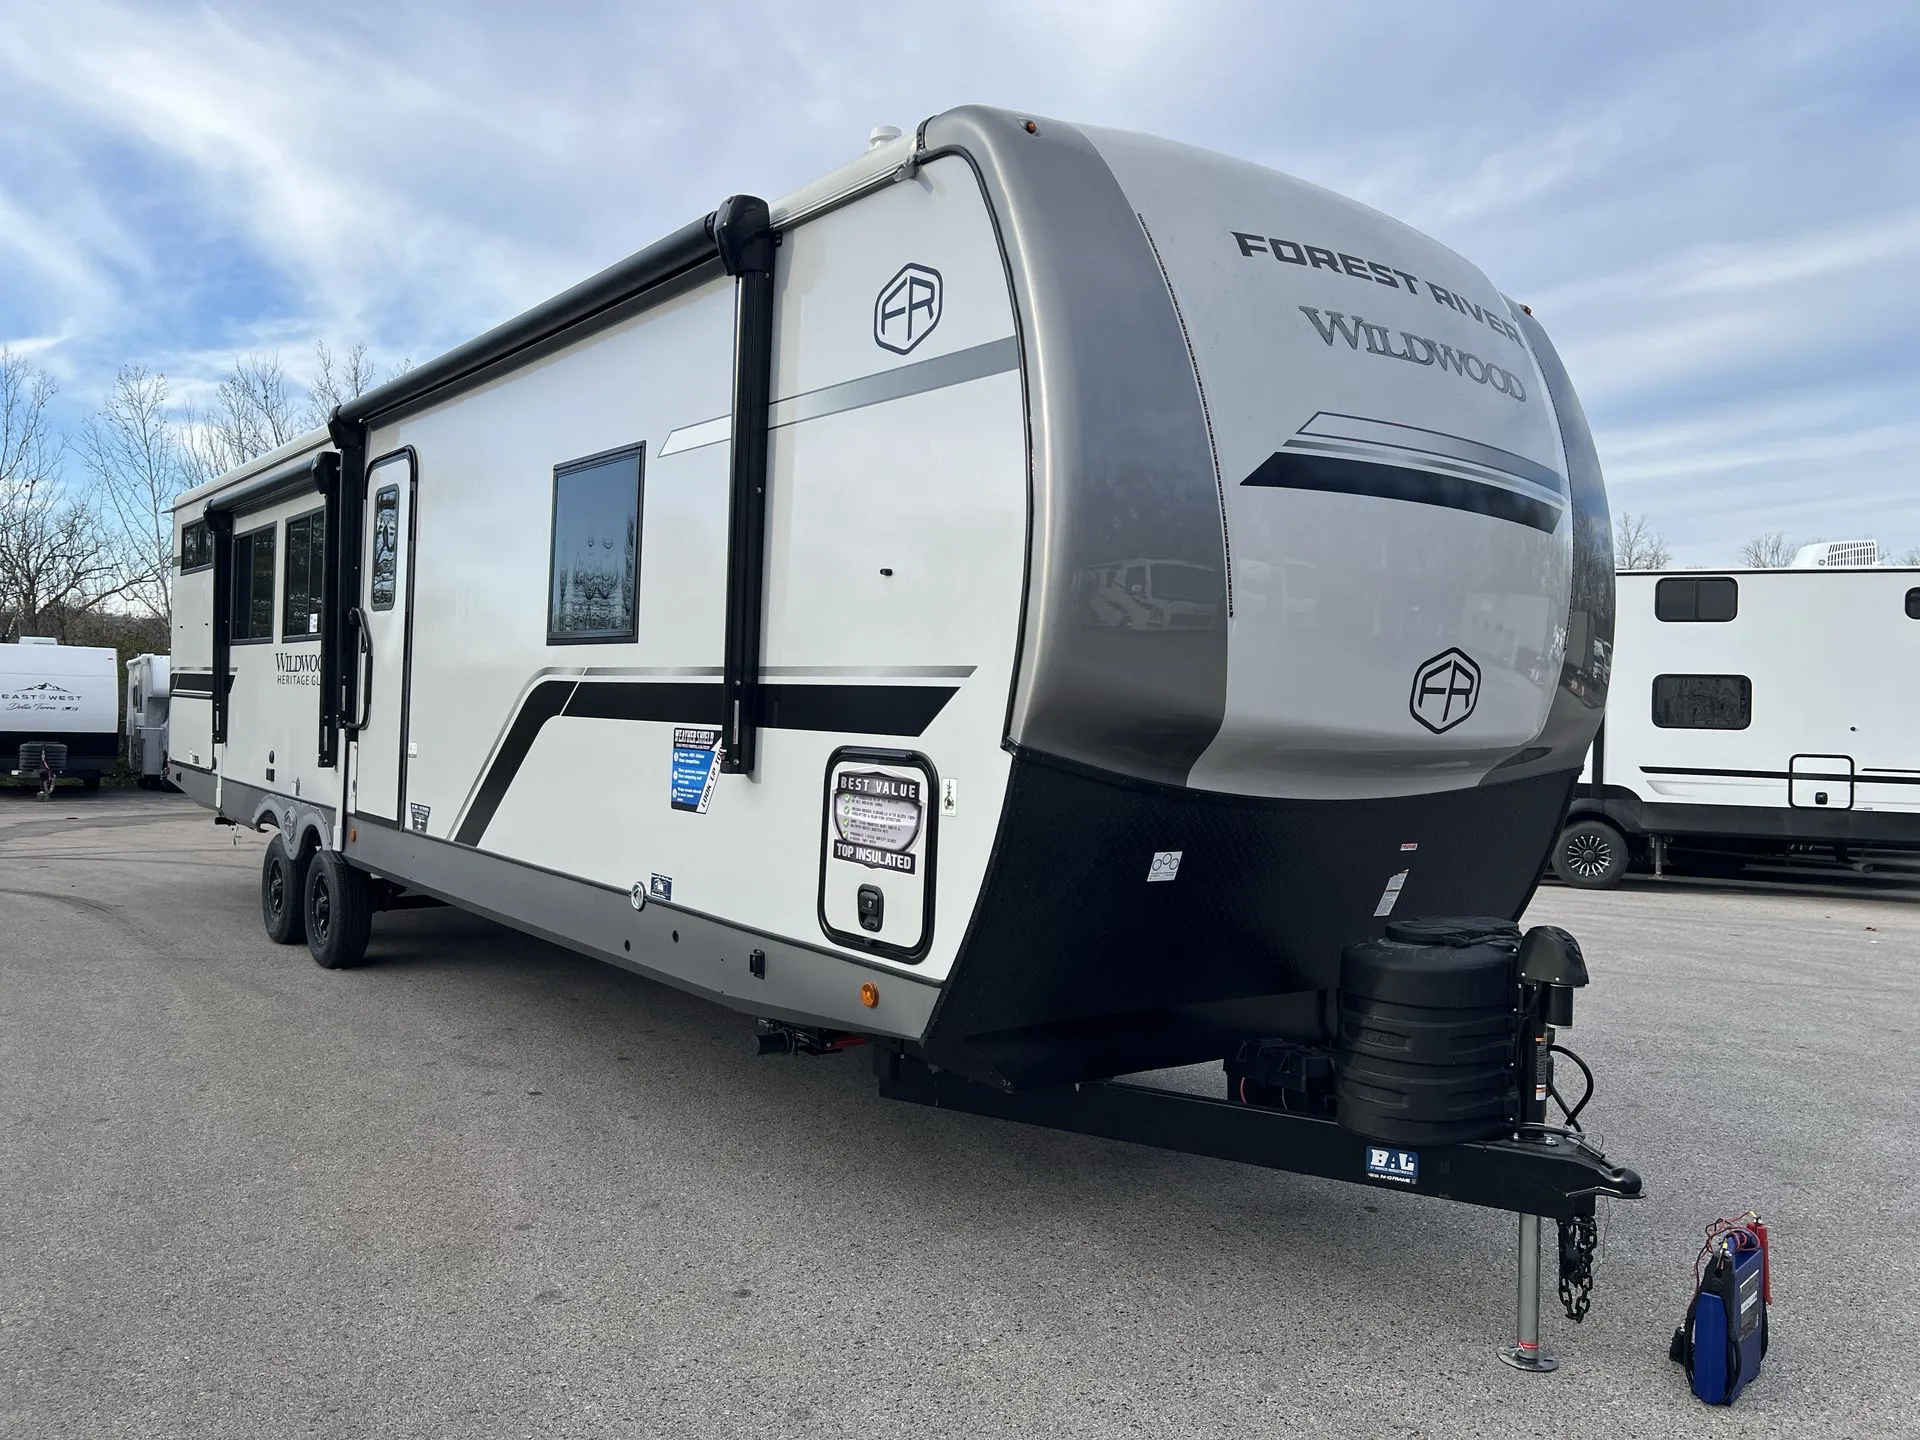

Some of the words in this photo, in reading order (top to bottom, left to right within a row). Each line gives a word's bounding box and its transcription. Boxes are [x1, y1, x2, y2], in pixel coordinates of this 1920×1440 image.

[1230, 231, 1418, 295] FOREST
[1424, 280, 1525, 349] RIVER
[1299, 304, 1527, 403] WILDWOOD
[277, 675, 309, 685] HERITAGE
[840, 776, 870, 792] BEST
[876, 780, 916, 798] VALUE
[836, 843, 854, 858] TOP
[855, 847, 912, 870] INSULATED
[1370, 1149, 1415, 1171] BAL
